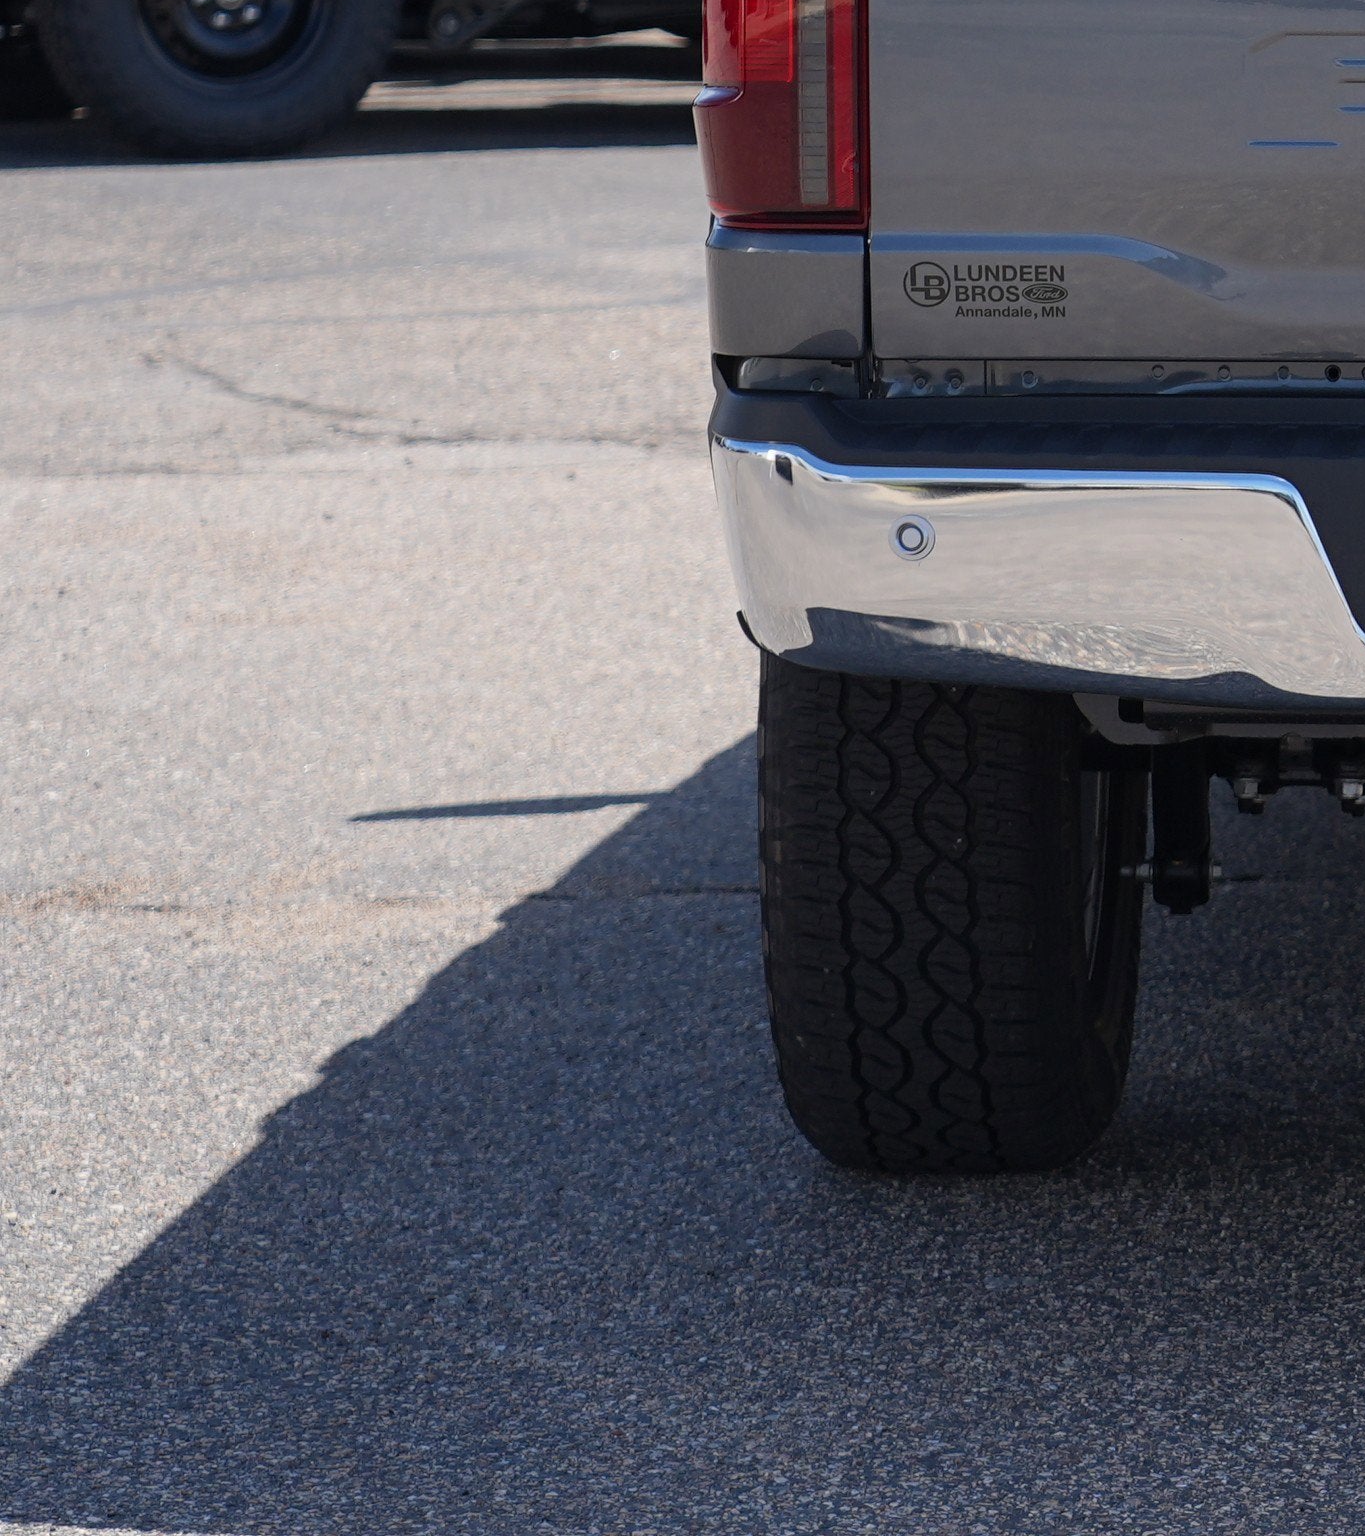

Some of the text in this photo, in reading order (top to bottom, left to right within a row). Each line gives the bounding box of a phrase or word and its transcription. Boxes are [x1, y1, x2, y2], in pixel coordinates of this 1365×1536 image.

[953, 264, 1065, 282] LUNDEEN
[955, 285, 1020, 302] BROS
[955, 306, 1066, 320] Annandale, MN
